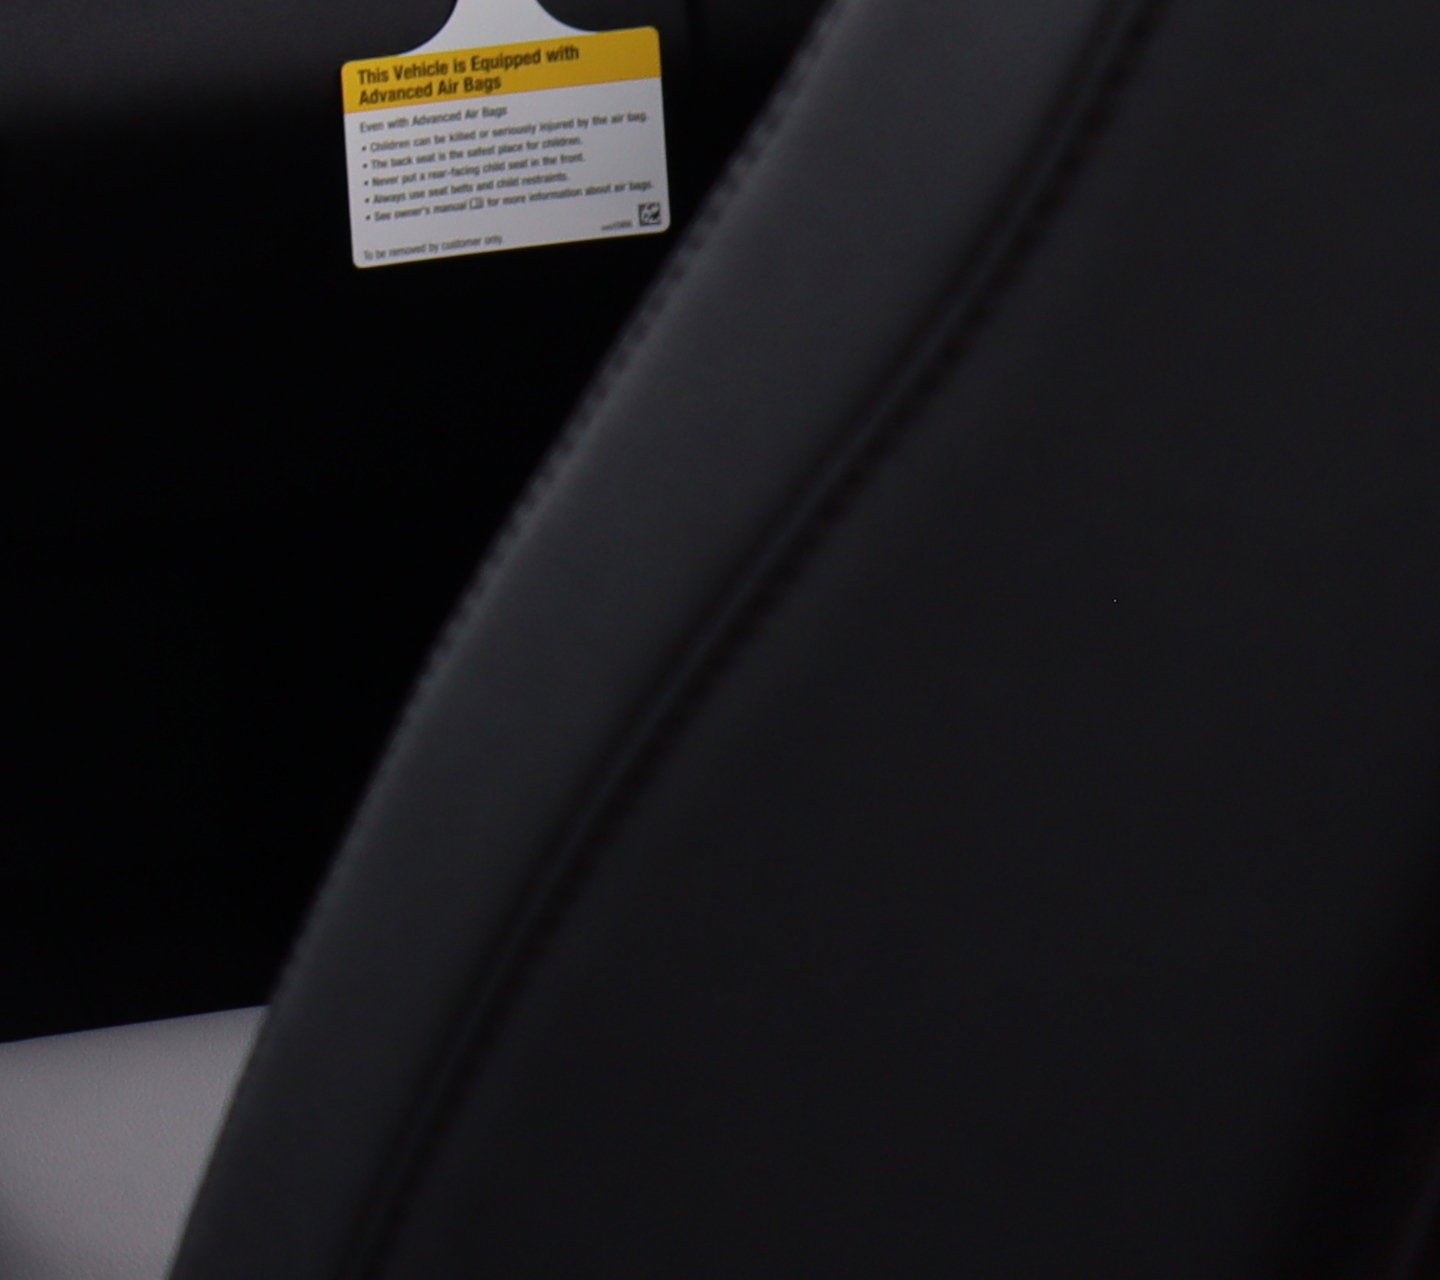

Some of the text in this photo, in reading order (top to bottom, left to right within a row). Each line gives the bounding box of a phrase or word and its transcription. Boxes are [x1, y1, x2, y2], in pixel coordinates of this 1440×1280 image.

[358, 45, 579, 84] This Vehicle is Equipped with
[359, 74, 501, 104] Advanced Air Bags
[359, 104, 508, 132] Even with Advanced Air Bags
